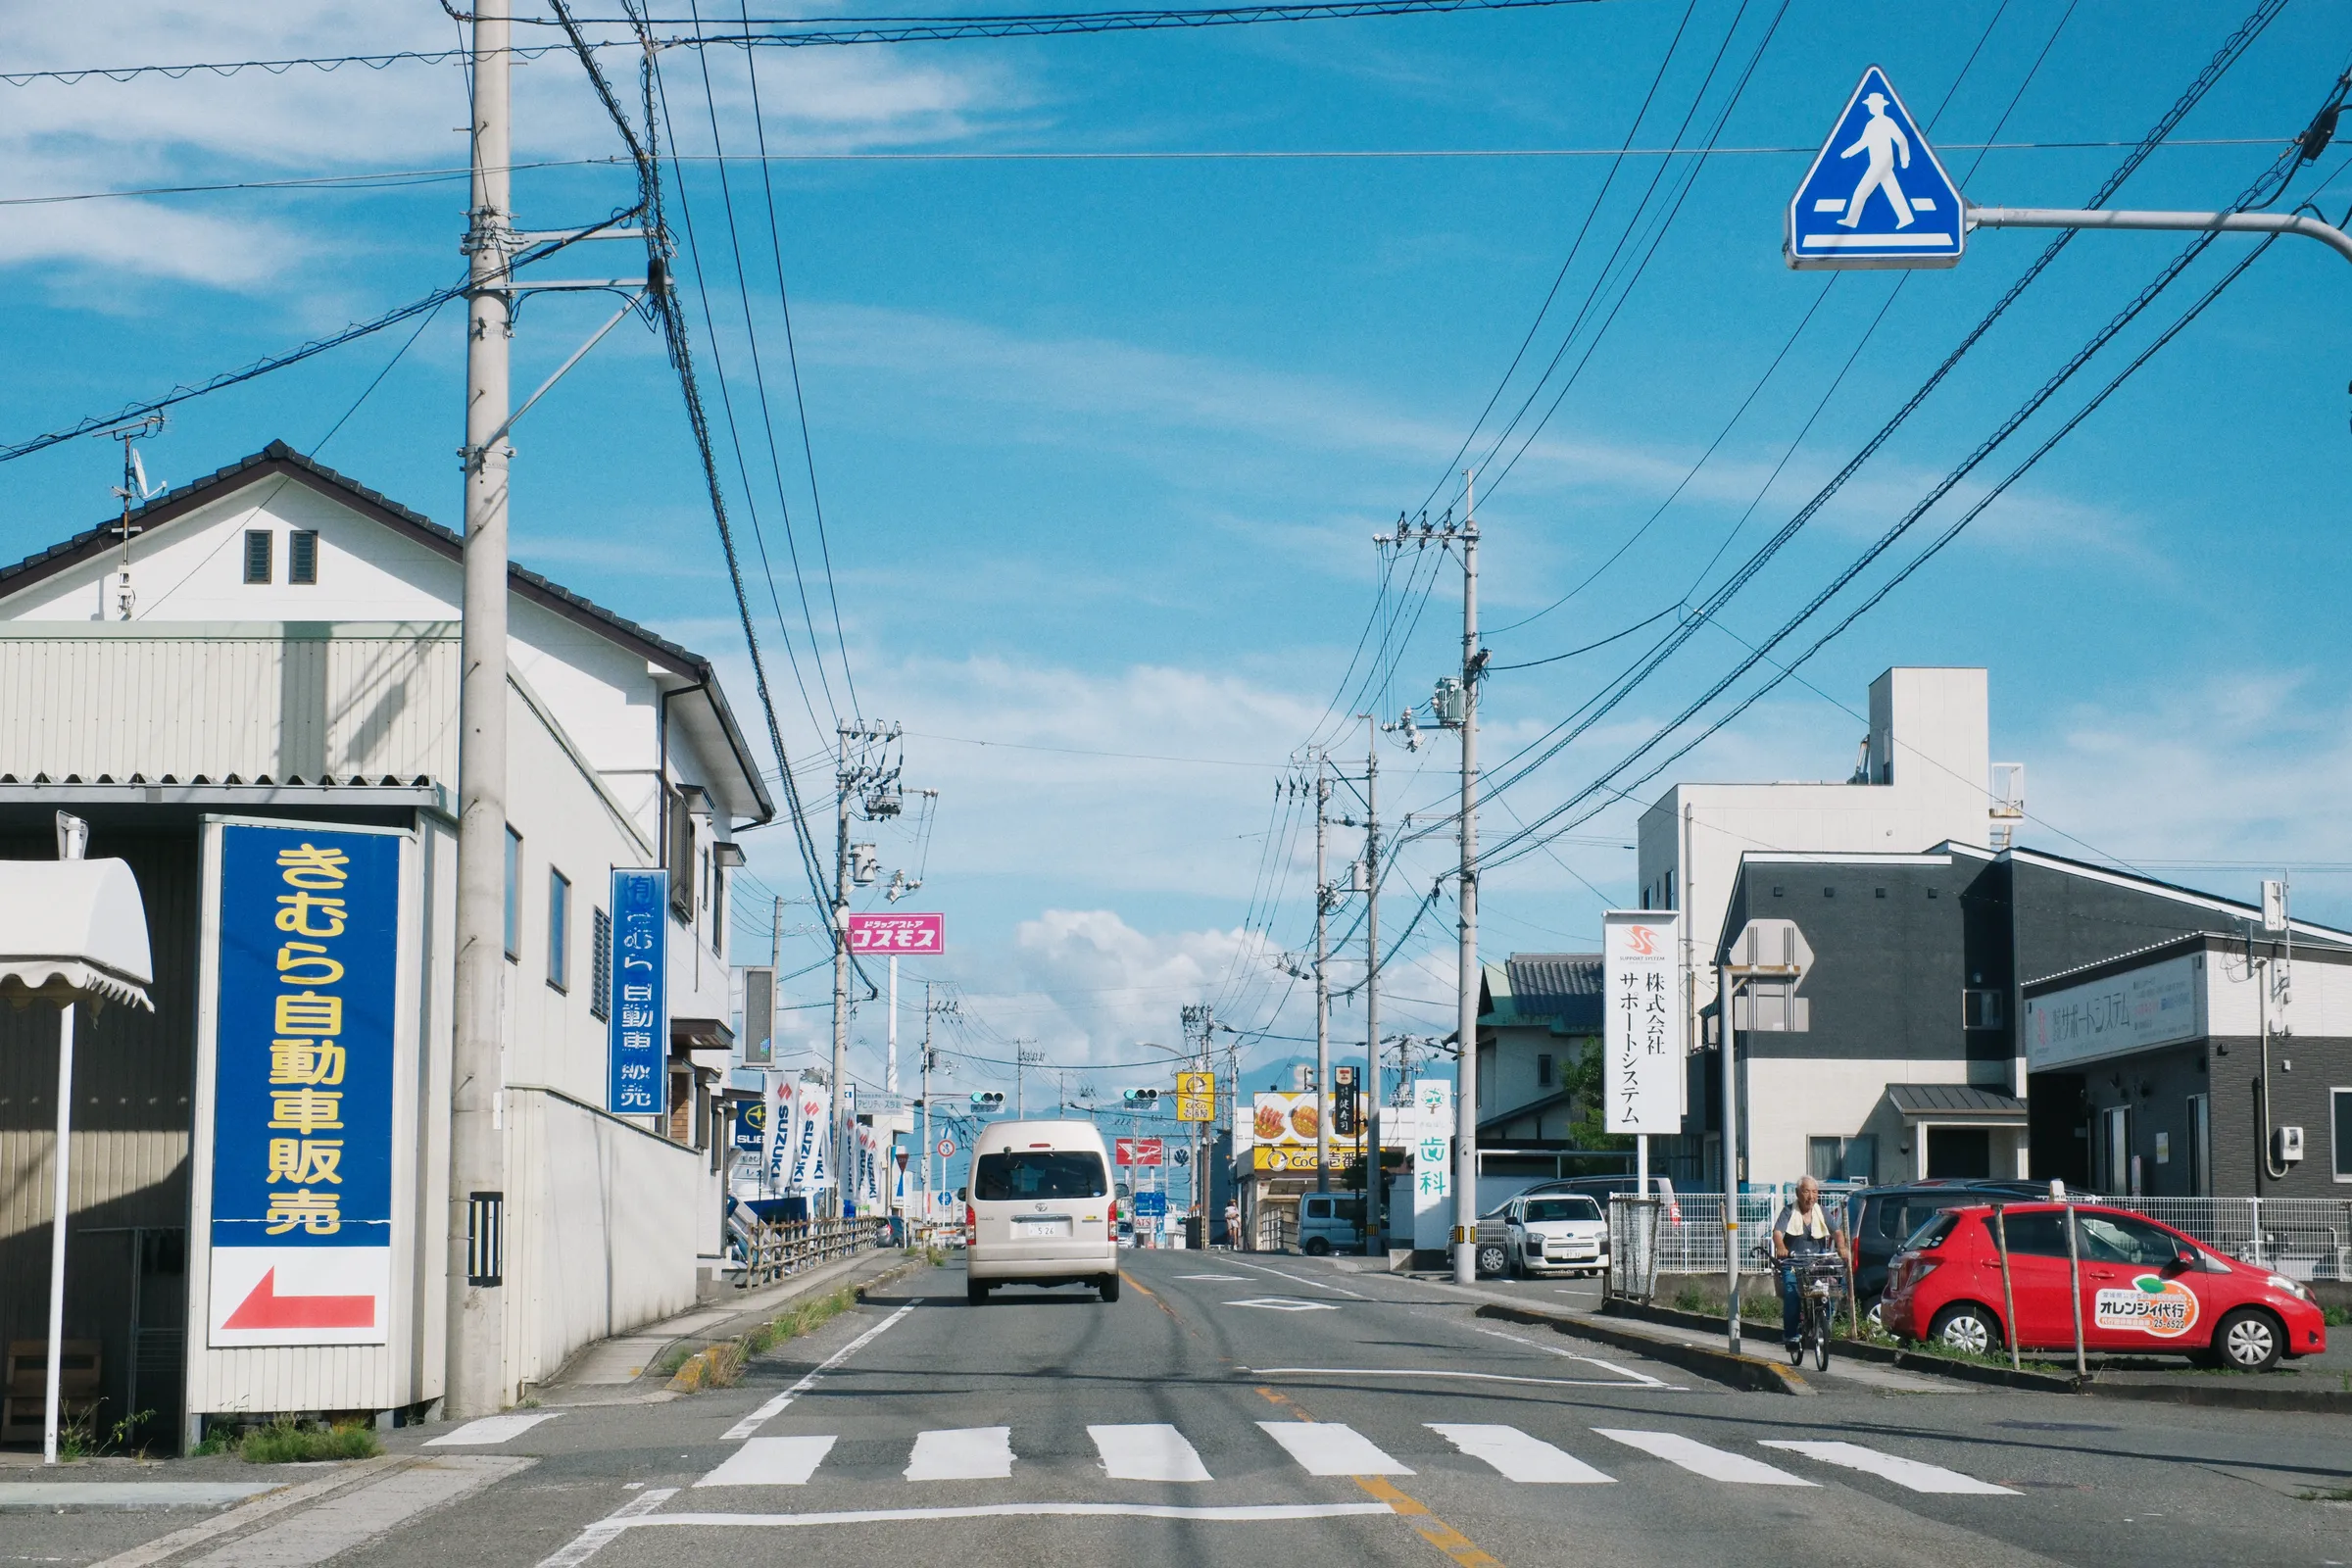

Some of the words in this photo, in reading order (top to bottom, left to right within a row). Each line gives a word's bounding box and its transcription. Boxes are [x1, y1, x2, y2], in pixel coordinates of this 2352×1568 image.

[853, 929, 936, 948] コスモス
[863, 920, 924, 929] ドラッグストア
[266, 843, 350, 1235] きむら自動車販売
[1644, 972, 1666, 1055] 株式会社
[2062, 992, 2131, 1041] サポートシステム
[1619, 972, 1640, 1124] サポートシステム
[770, 1104, 789, 1178] SUZUKI
[1419, 1137, 1446, 1196] 歯科
[867, 1152, 877, 1199] SUZUKI
[2153, 1319, 2184, 1329] 25-6522
